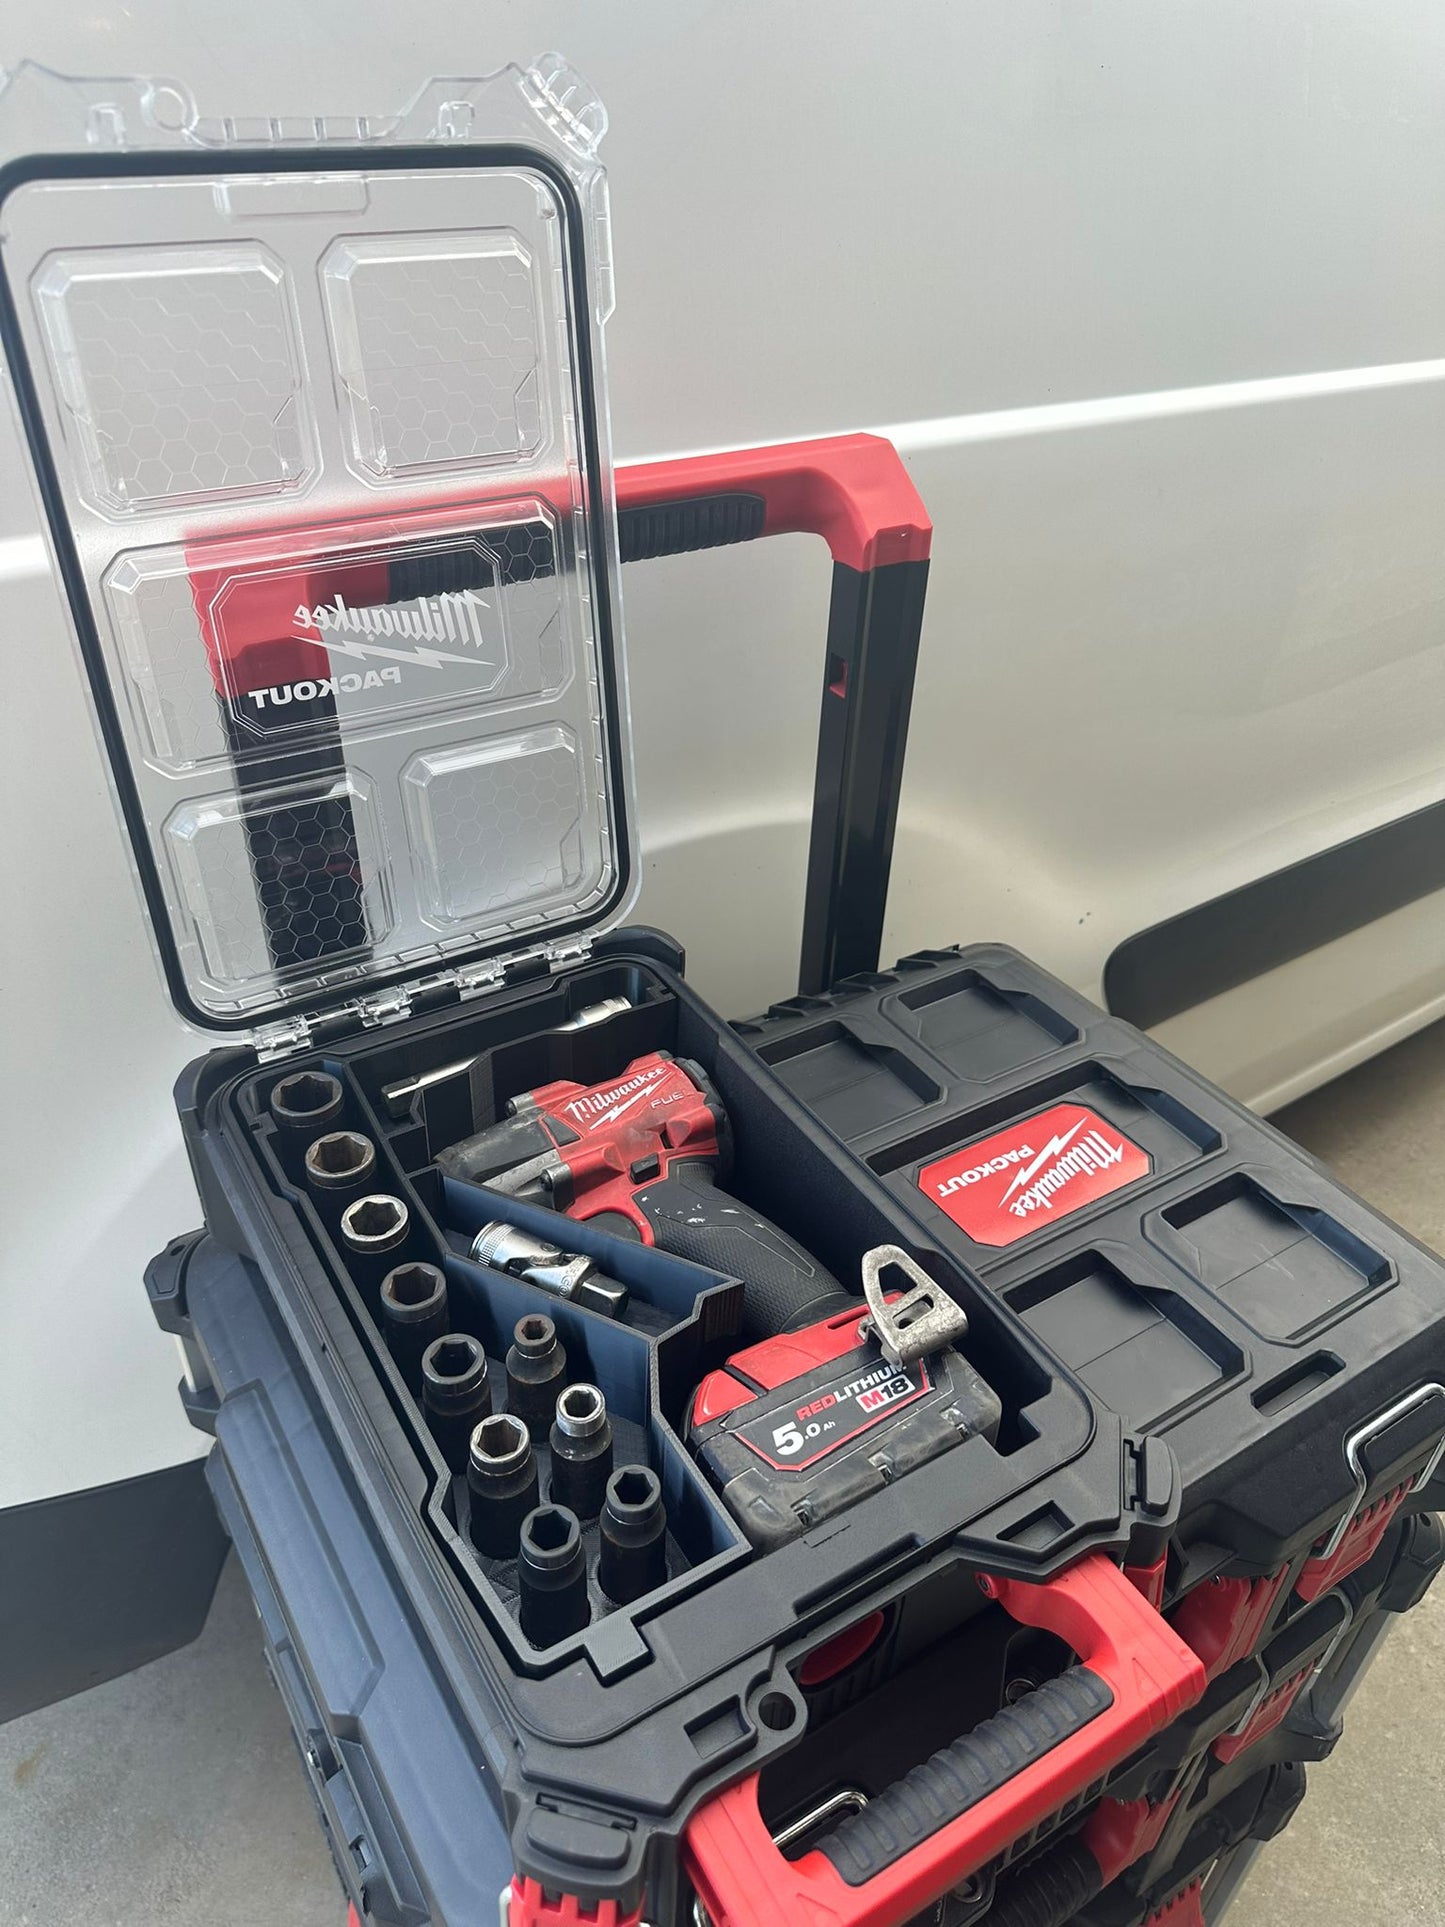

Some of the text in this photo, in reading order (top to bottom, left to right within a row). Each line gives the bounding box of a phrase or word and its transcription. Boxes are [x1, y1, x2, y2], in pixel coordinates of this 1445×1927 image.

[564, 1067, 667, 1124] Milwaukee
[937, 1144, 1035, 1197] PACKOUT
[1009, 1130, 1123, 1217] Milwaukee
[860, 1378, 910, 1409] M18
[772, 1421, 836, 1456] 5.0 Ah
